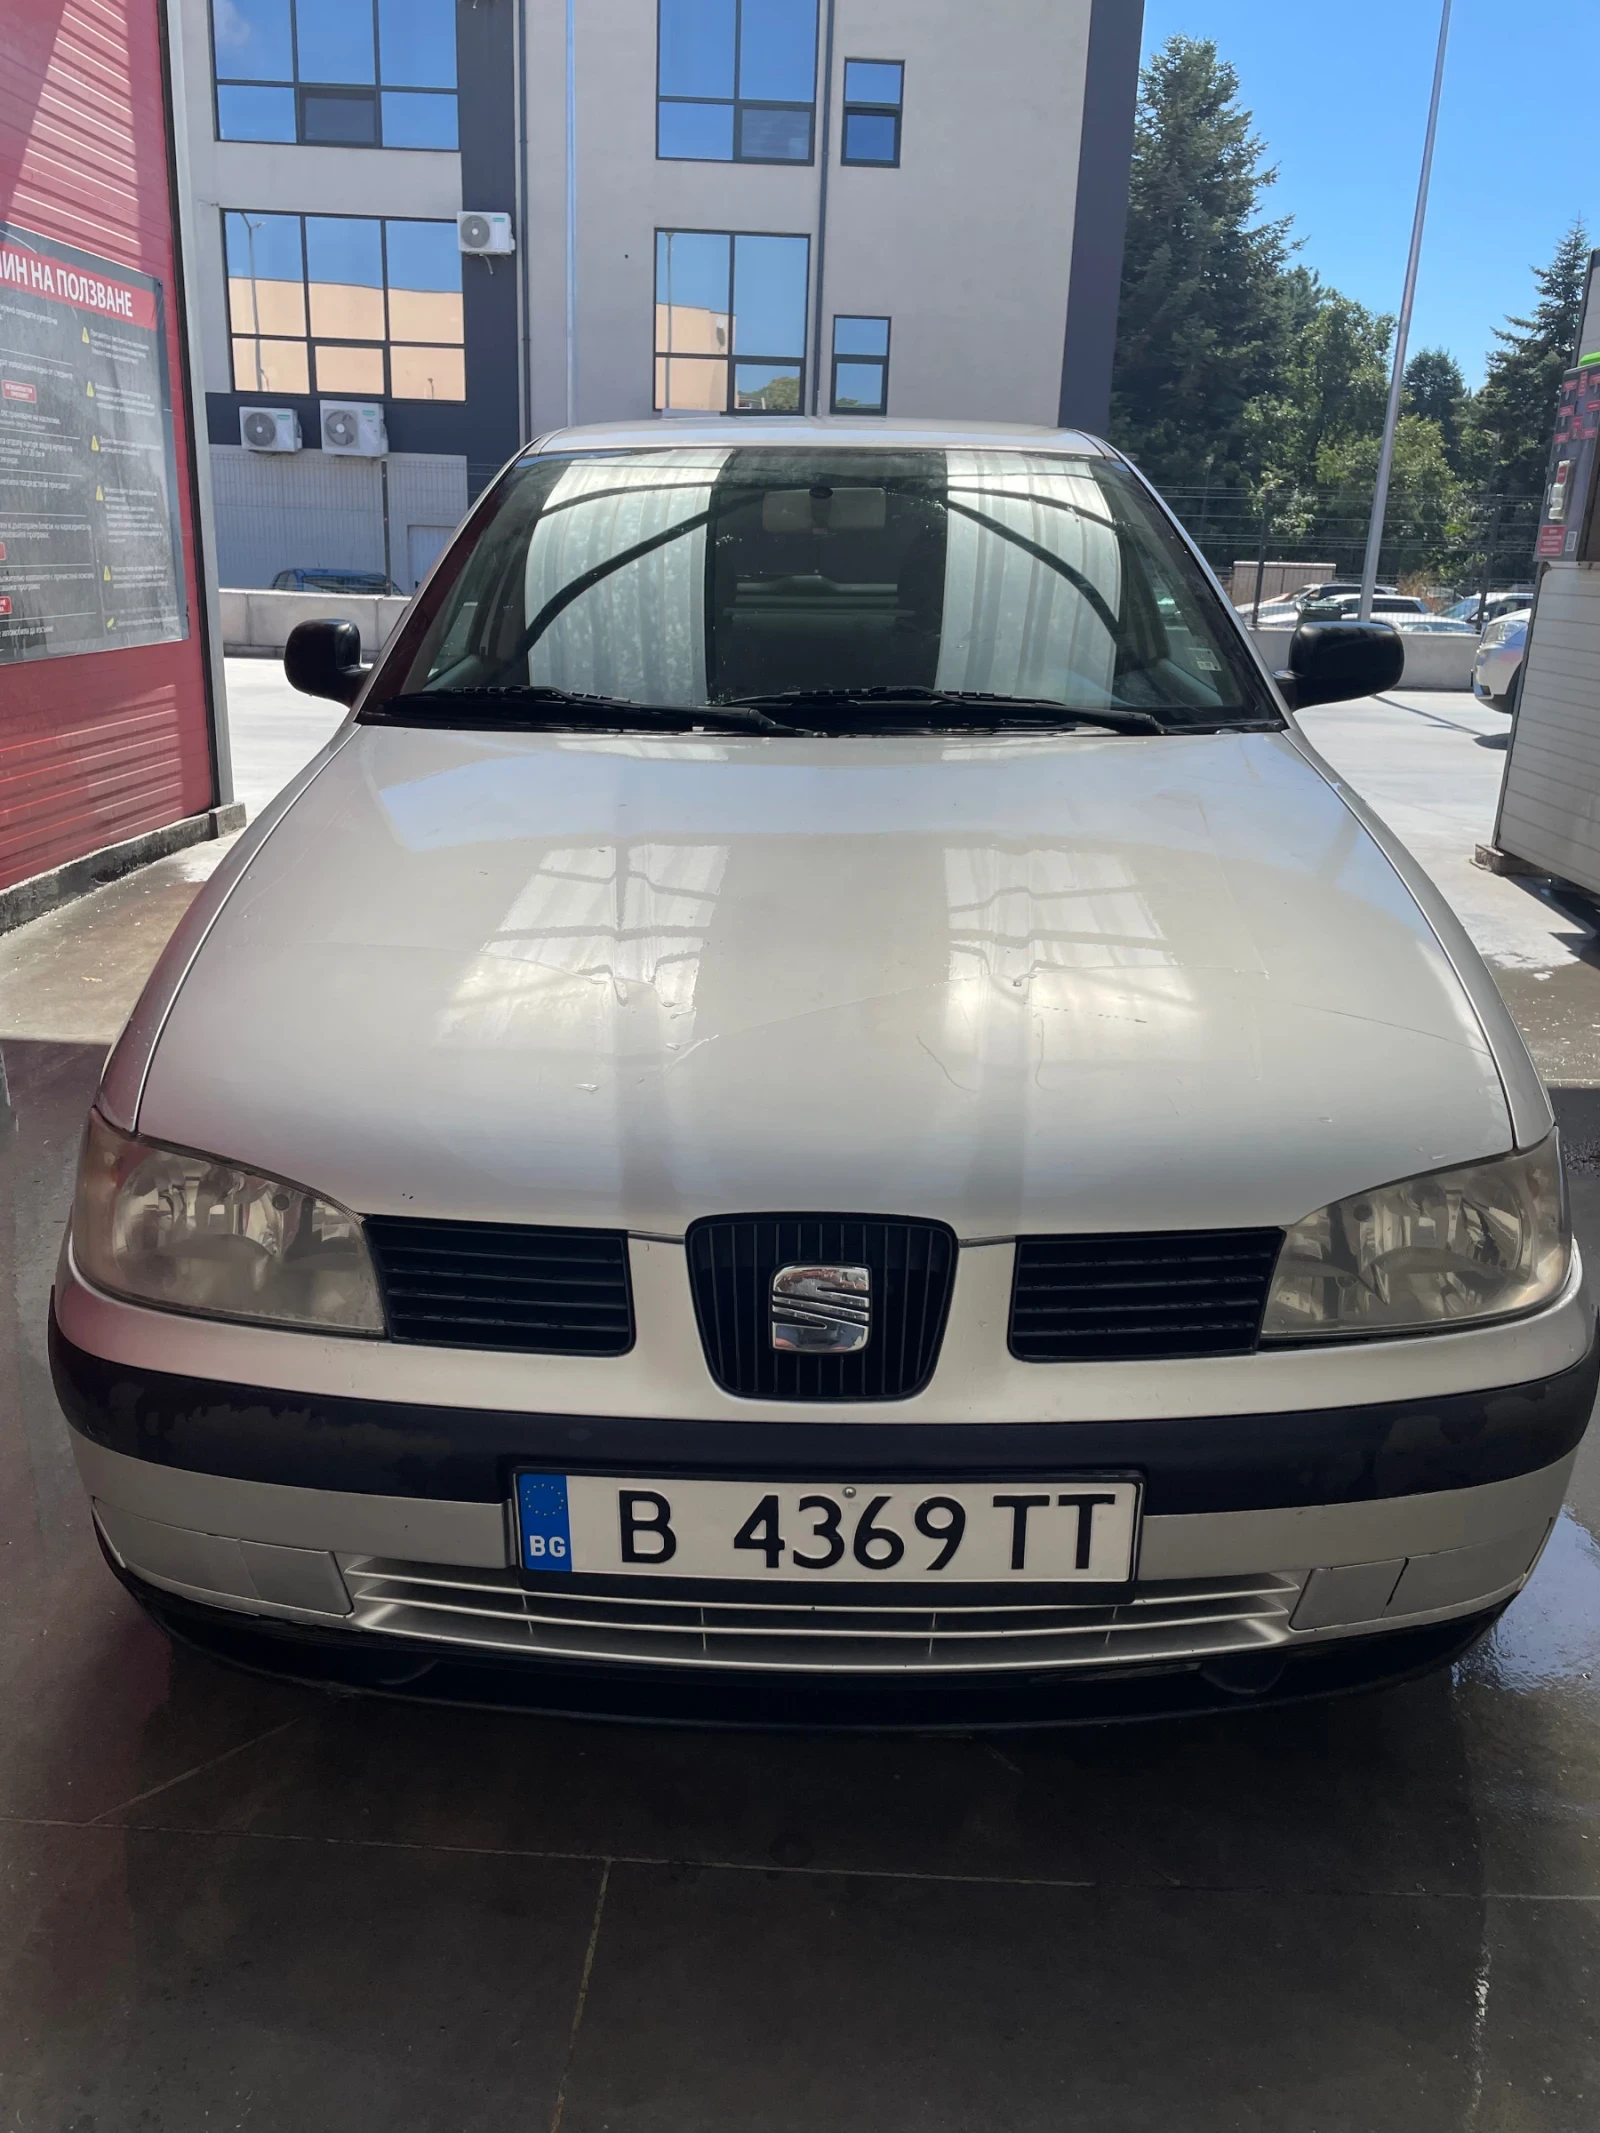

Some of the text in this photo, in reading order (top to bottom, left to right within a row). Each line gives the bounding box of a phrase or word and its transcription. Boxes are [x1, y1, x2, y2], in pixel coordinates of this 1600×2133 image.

[0, 250, 28, 285] ИН
[30, 260, 55, 294] НА
[56, 268, 134, 318] ПОЛЗВАНЕ
[529, 1534, 567, 1558] BG
[618, 1491, 1117, 1571] B 4369 TT
